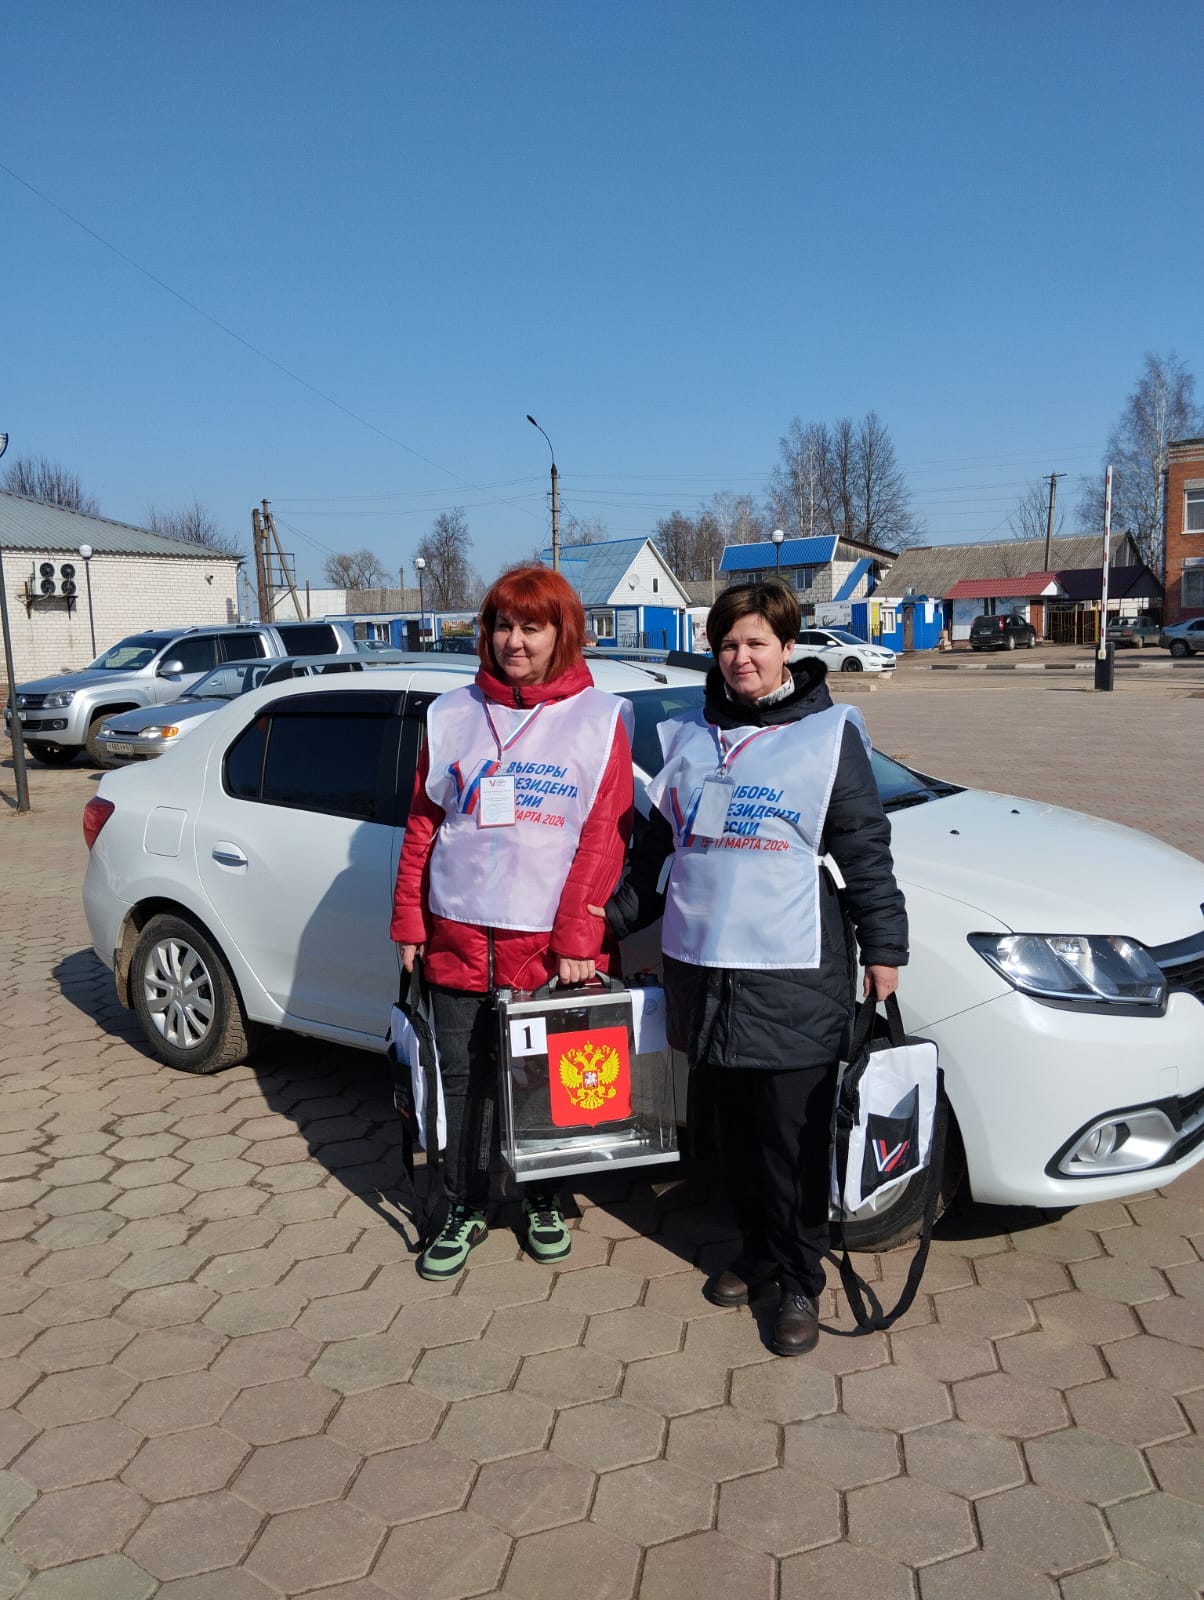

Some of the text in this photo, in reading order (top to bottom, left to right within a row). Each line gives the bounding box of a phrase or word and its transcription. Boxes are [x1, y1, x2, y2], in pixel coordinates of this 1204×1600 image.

[506, 761, 568, 779] ВЫБОРЫ
[515, 777, 578, 799] ЕЗИДЕНТА
[515, 793, 544, 808] СИИ
[542, 814, 566, 828] 2024
[727, 803, 801, 824] ЕЗИДЕНТА
[724, 837, 762, 850] МАРТА
[763, 839, 791, 852] 2024
[522, 1024, 533, 1050] 1
